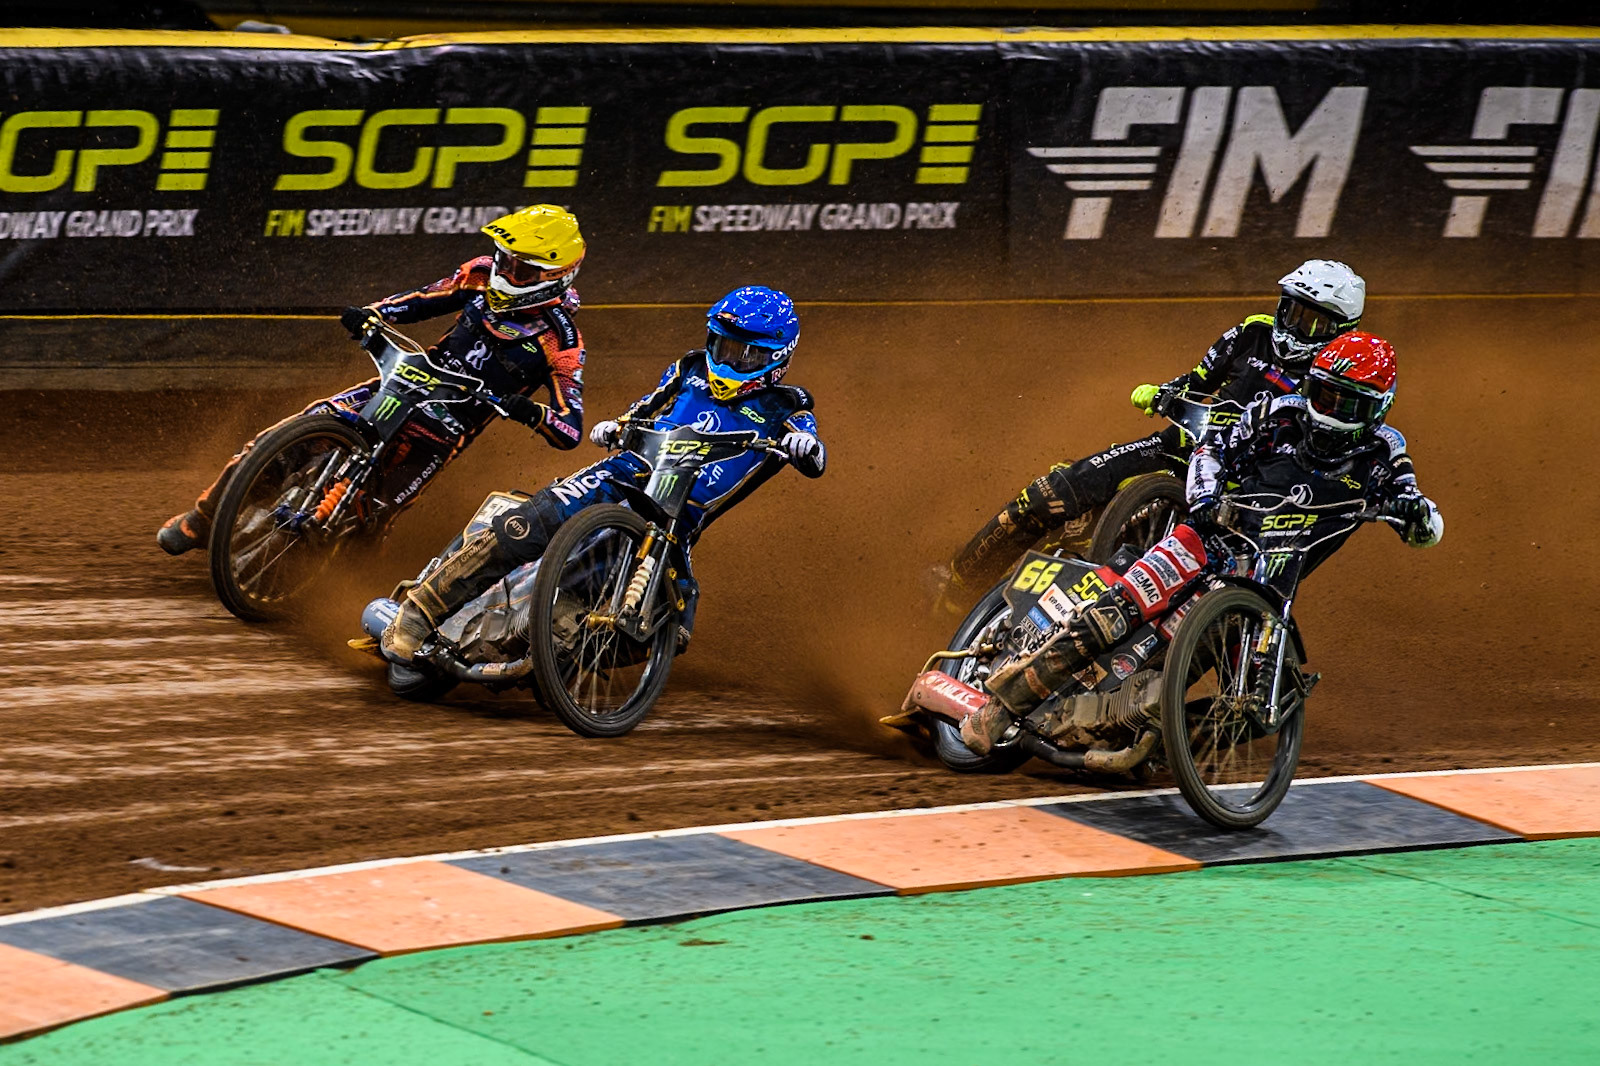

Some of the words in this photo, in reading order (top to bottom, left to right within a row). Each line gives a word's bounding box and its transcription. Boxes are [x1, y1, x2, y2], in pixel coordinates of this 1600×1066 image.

[274, 107, 526, 190] SGP
[656, 105, 917, 187] SGP
[1026, 86, 1368, 239] FIM
[1409, 87, 1600, 238] FI
[65, 210, 144, 238] GRAND
[143, 209, 199, 237] PRIX
[264, 209, 306, 236] FIM
[306, 207, 424, 236] SPEEDWAY
[648, 205, 693, 232] FIM
[693, 204, 820, 232] SPEEDWAY
[819, 203, 900, 231] GRAND
[902, 202, 961, 229] PRIX
[740, 406, 766, 424] SGP
[421, 462, 438, 479] ECO
[394, 477, 423, 504] CENTER
[1261, 514, 1306, 531] SGP
[1013, 559, 1064, 595] 66
